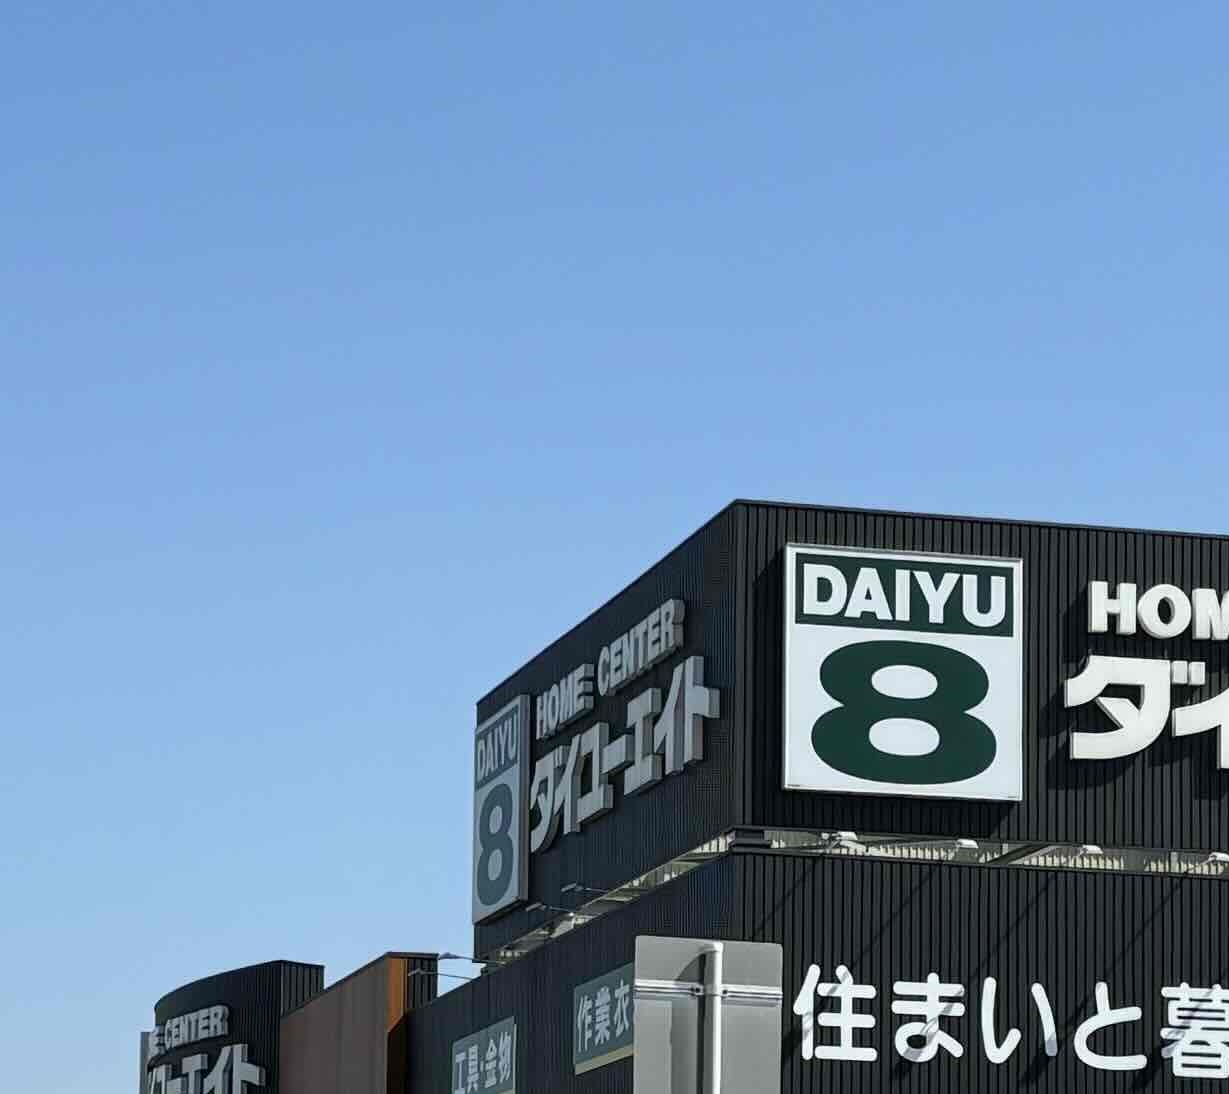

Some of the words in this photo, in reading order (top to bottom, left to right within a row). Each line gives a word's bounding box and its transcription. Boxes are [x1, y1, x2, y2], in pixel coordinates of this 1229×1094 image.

[802, 563, 1007, 628] DAIYU
[535, 663, 594, 740] HOME
[597, 598, 686, 697] CENTER
[811, 639, 998, 785] 8
[477, 710, 519, 780] DAIYU
[530, 656, 720, 853] ダイユーエイト
[477, 783, 514, 907] 8
[164, 1005, 229, 1051] CENTER
